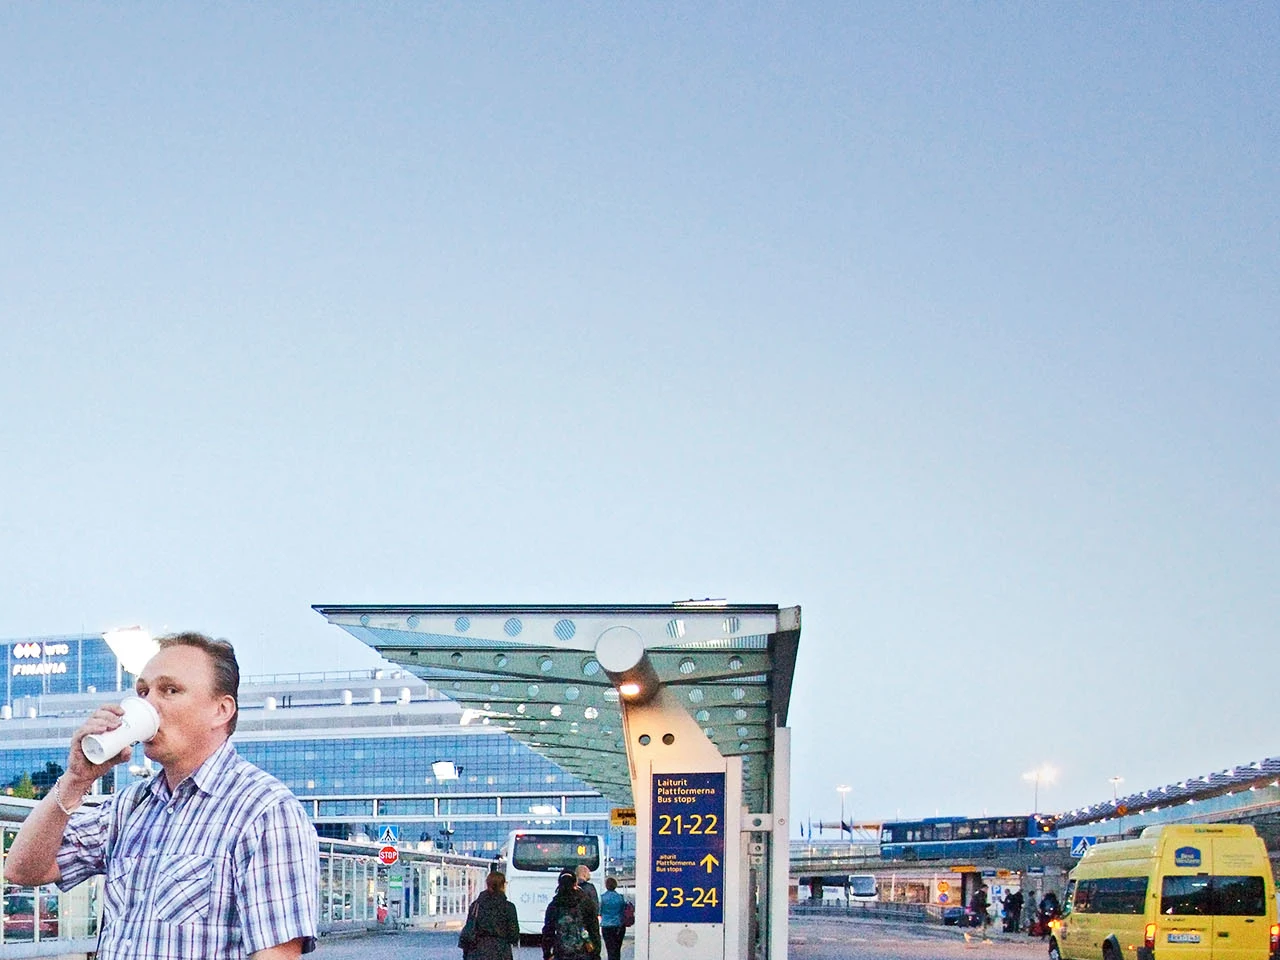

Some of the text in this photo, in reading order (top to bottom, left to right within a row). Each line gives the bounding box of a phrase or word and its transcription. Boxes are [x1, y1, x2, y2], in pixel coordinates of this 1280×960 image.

[13, 663, 66, 676] FINAVIA
[657, 778, 688, 787] Laiturit
[657, 787, 716, 795] Plattformerna
[674, 796, 696, 804] stops
[658, 814, 717, 834] 21-22
[379, 851, 397, 859] STOP
[655, 887, 718, 907] 23-24
